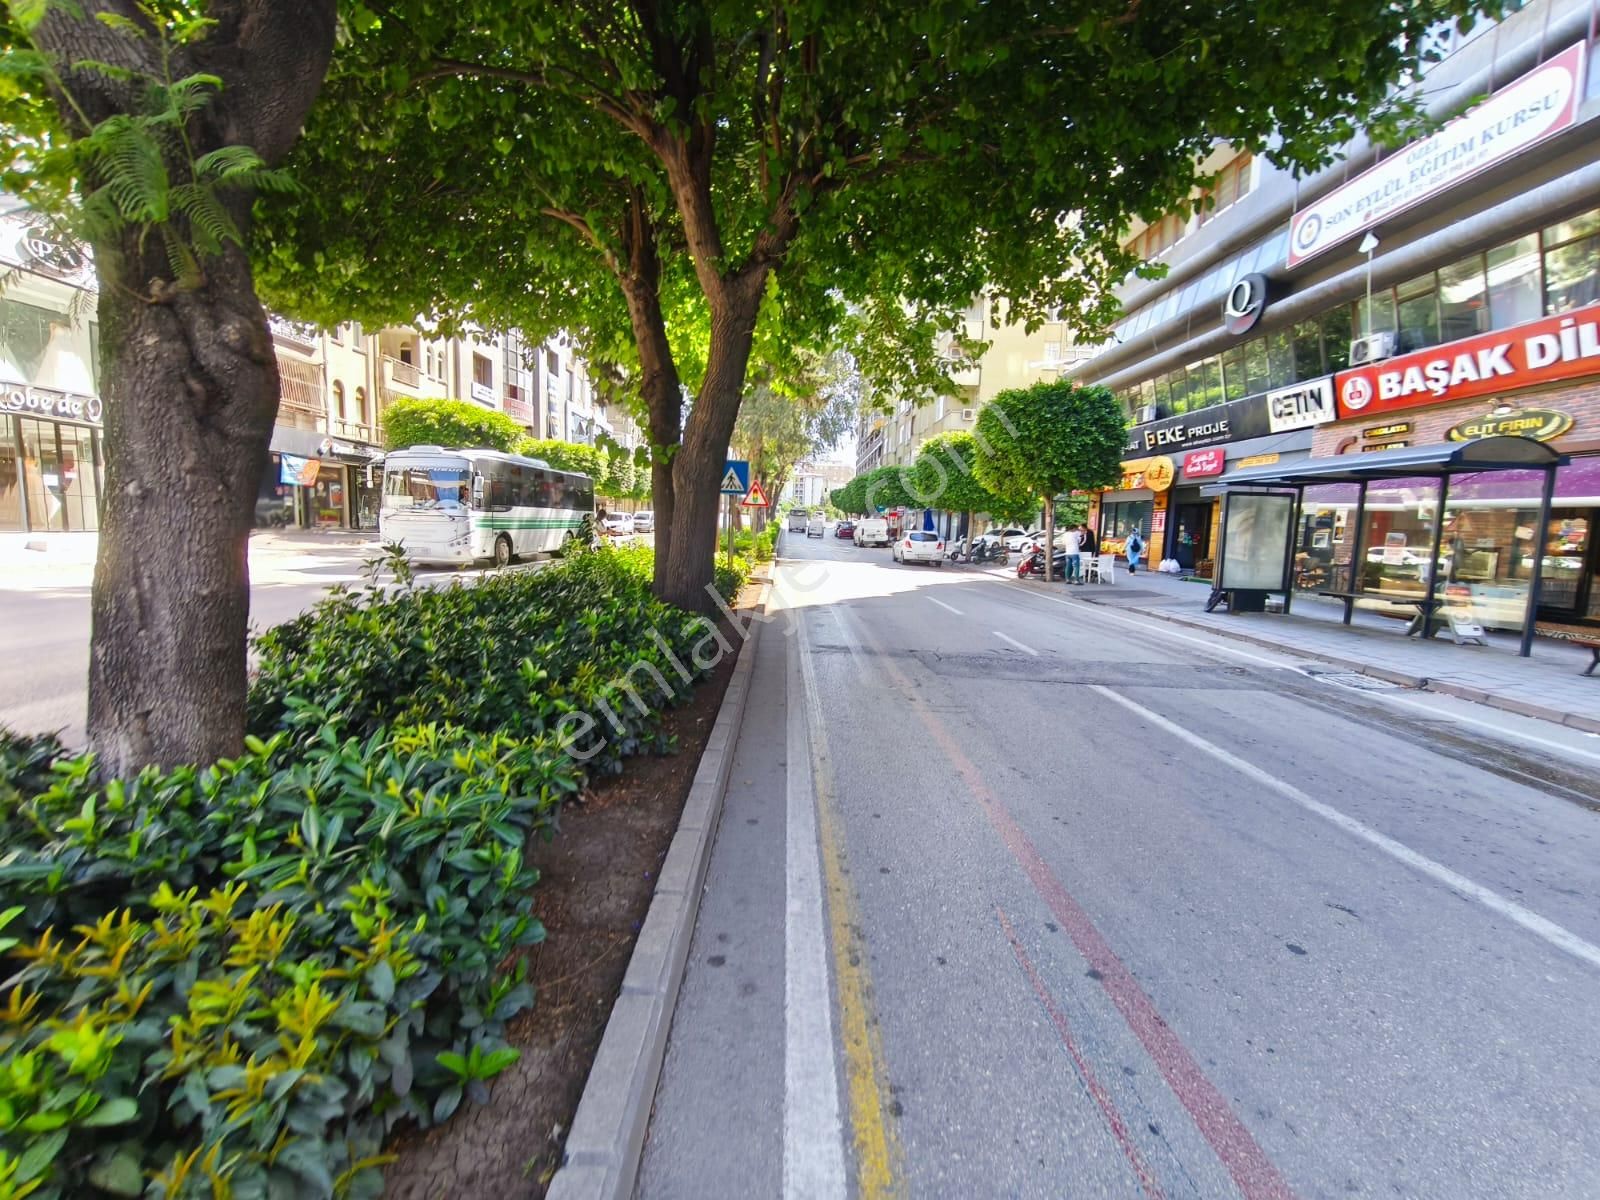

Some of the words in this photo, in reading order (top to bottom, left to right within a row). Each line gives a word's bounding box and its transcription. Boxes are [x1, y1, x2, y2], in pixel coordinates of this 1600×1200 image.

[1325, 204, 1353, 229] SON
[1355, 178, 1405, 213] EYLÜL
[1409, 135, 1476, 184] EĞİTİM
[1480, 89, 1560, 146] KURSU
[1378, 342, 1515, 400] BAŞAK
[1156, 424, 1186, 446] EKE
[1187, 420, 1229, 439] PROJE
